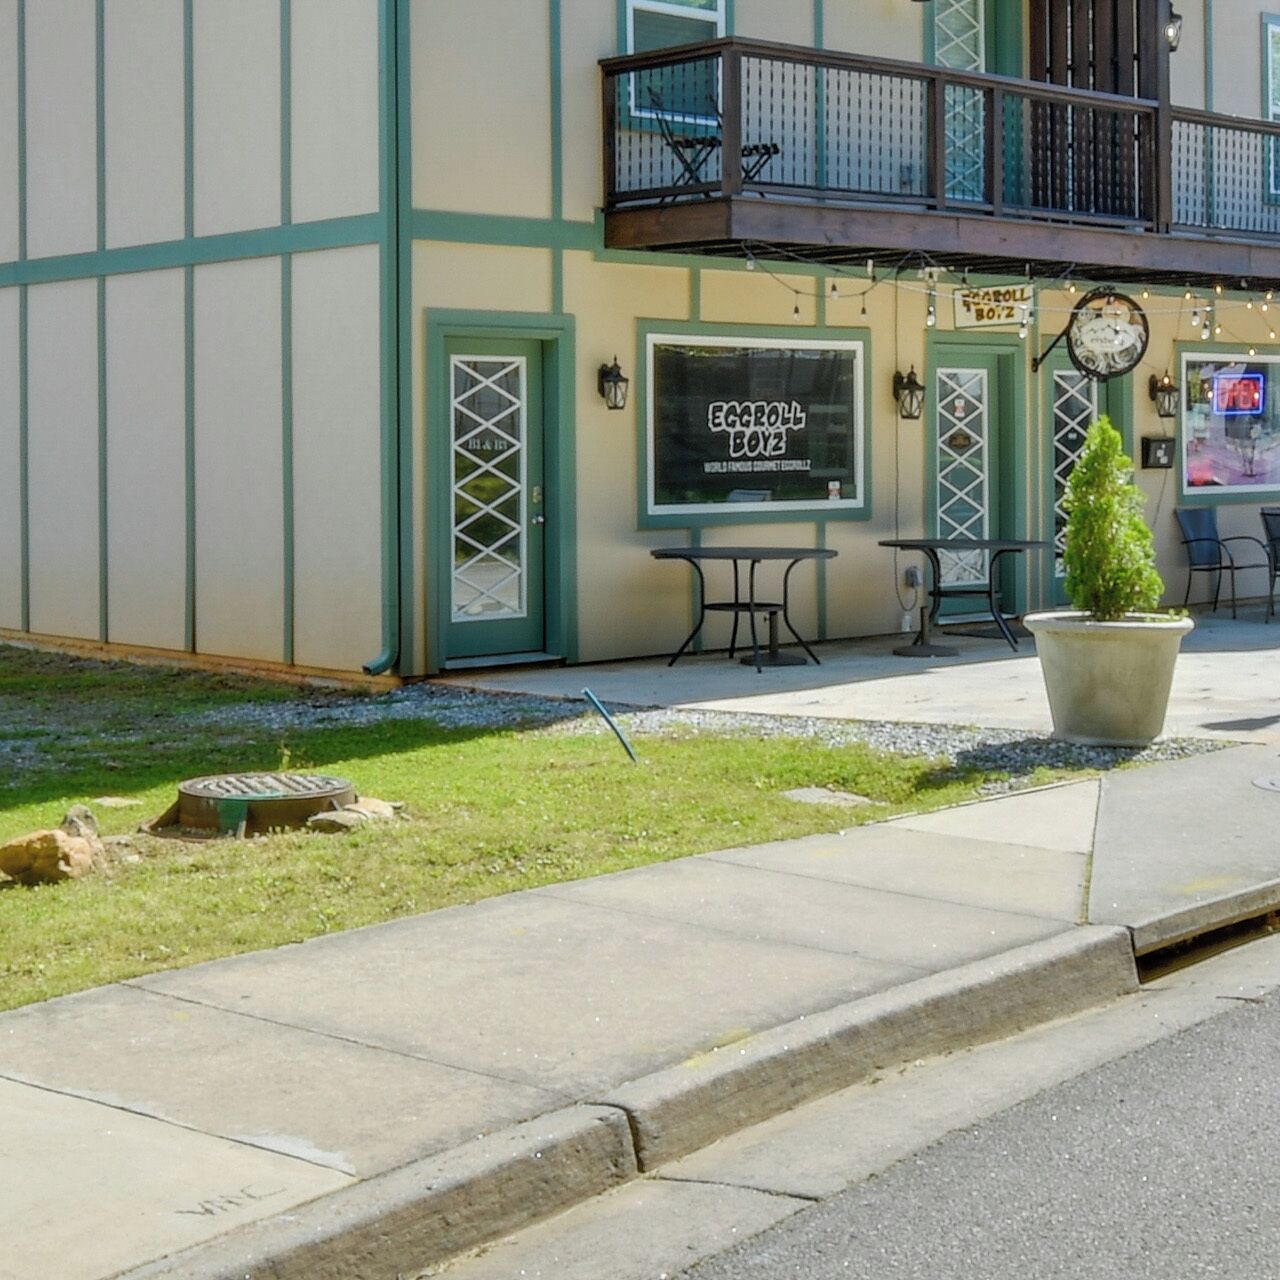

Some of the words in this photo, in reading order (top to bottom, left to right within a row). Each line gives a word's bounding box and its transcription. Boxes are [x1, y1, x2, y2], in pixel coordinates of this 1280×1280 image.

[1217, 379, 1261, 409] OPEN
[708, 400, 806, 433] EGGROLL
[729, 426, 787, 458] BOYZ
[704, 461, 727, 473] WORLD
[728, 460, 752, 473] FAMOUS
[753, 460, 780, 472] GOURMET
